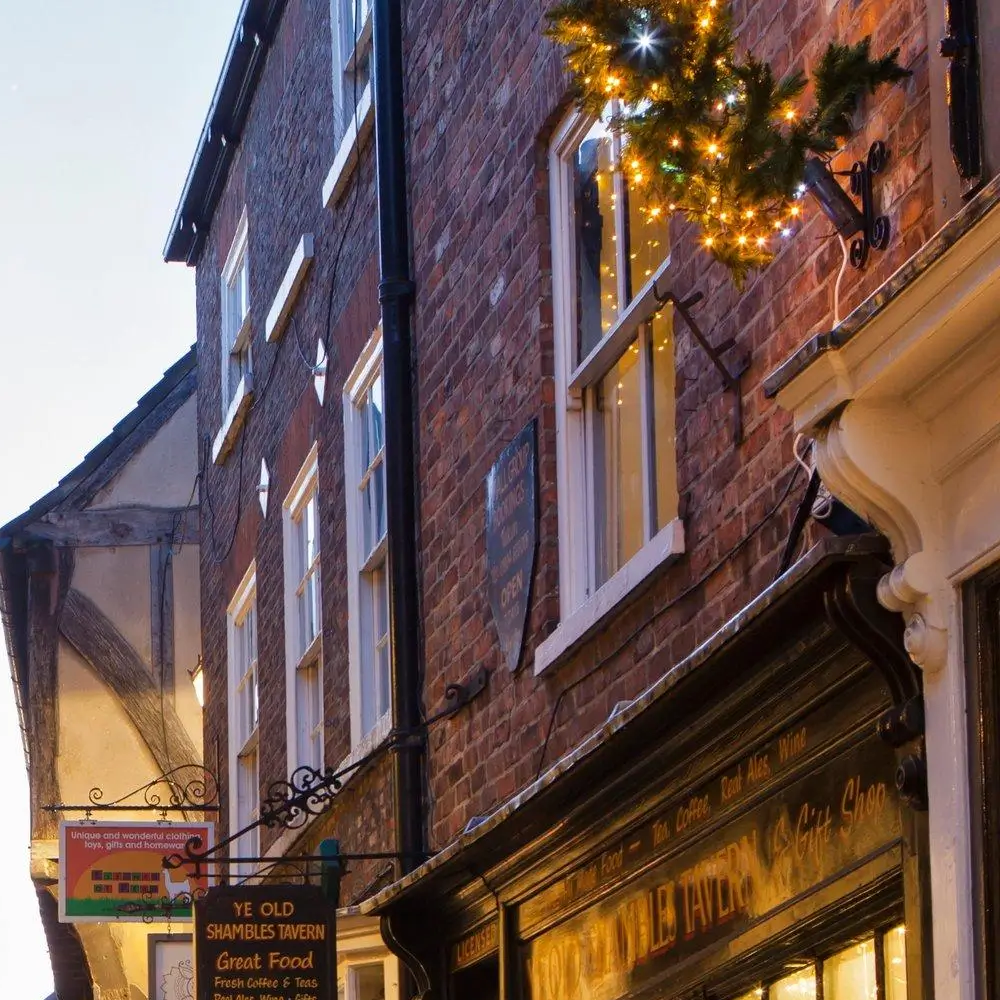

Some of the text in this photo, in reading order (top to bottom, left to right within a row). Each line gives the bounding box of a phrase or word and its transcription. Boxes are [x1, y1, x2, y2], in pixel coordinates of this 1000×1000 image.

[796, 802, 832, 866] Gift
[841, 775, 886, 824] Shop
[71, 831, 100, 842] Unique
[103, 831, 120, 840] and
[122, 831, 164, 840] wonderful
[84, 841, 186, 851] toys, gifts and homewar
[233, 902, 295, 916] YE OLD
[207, 923, 326, 940] SHAMBLES TAVERN
[216, 950, 314, 970] Great Food
[214, 976, 318, 989] Fresh Coffee & Teas
